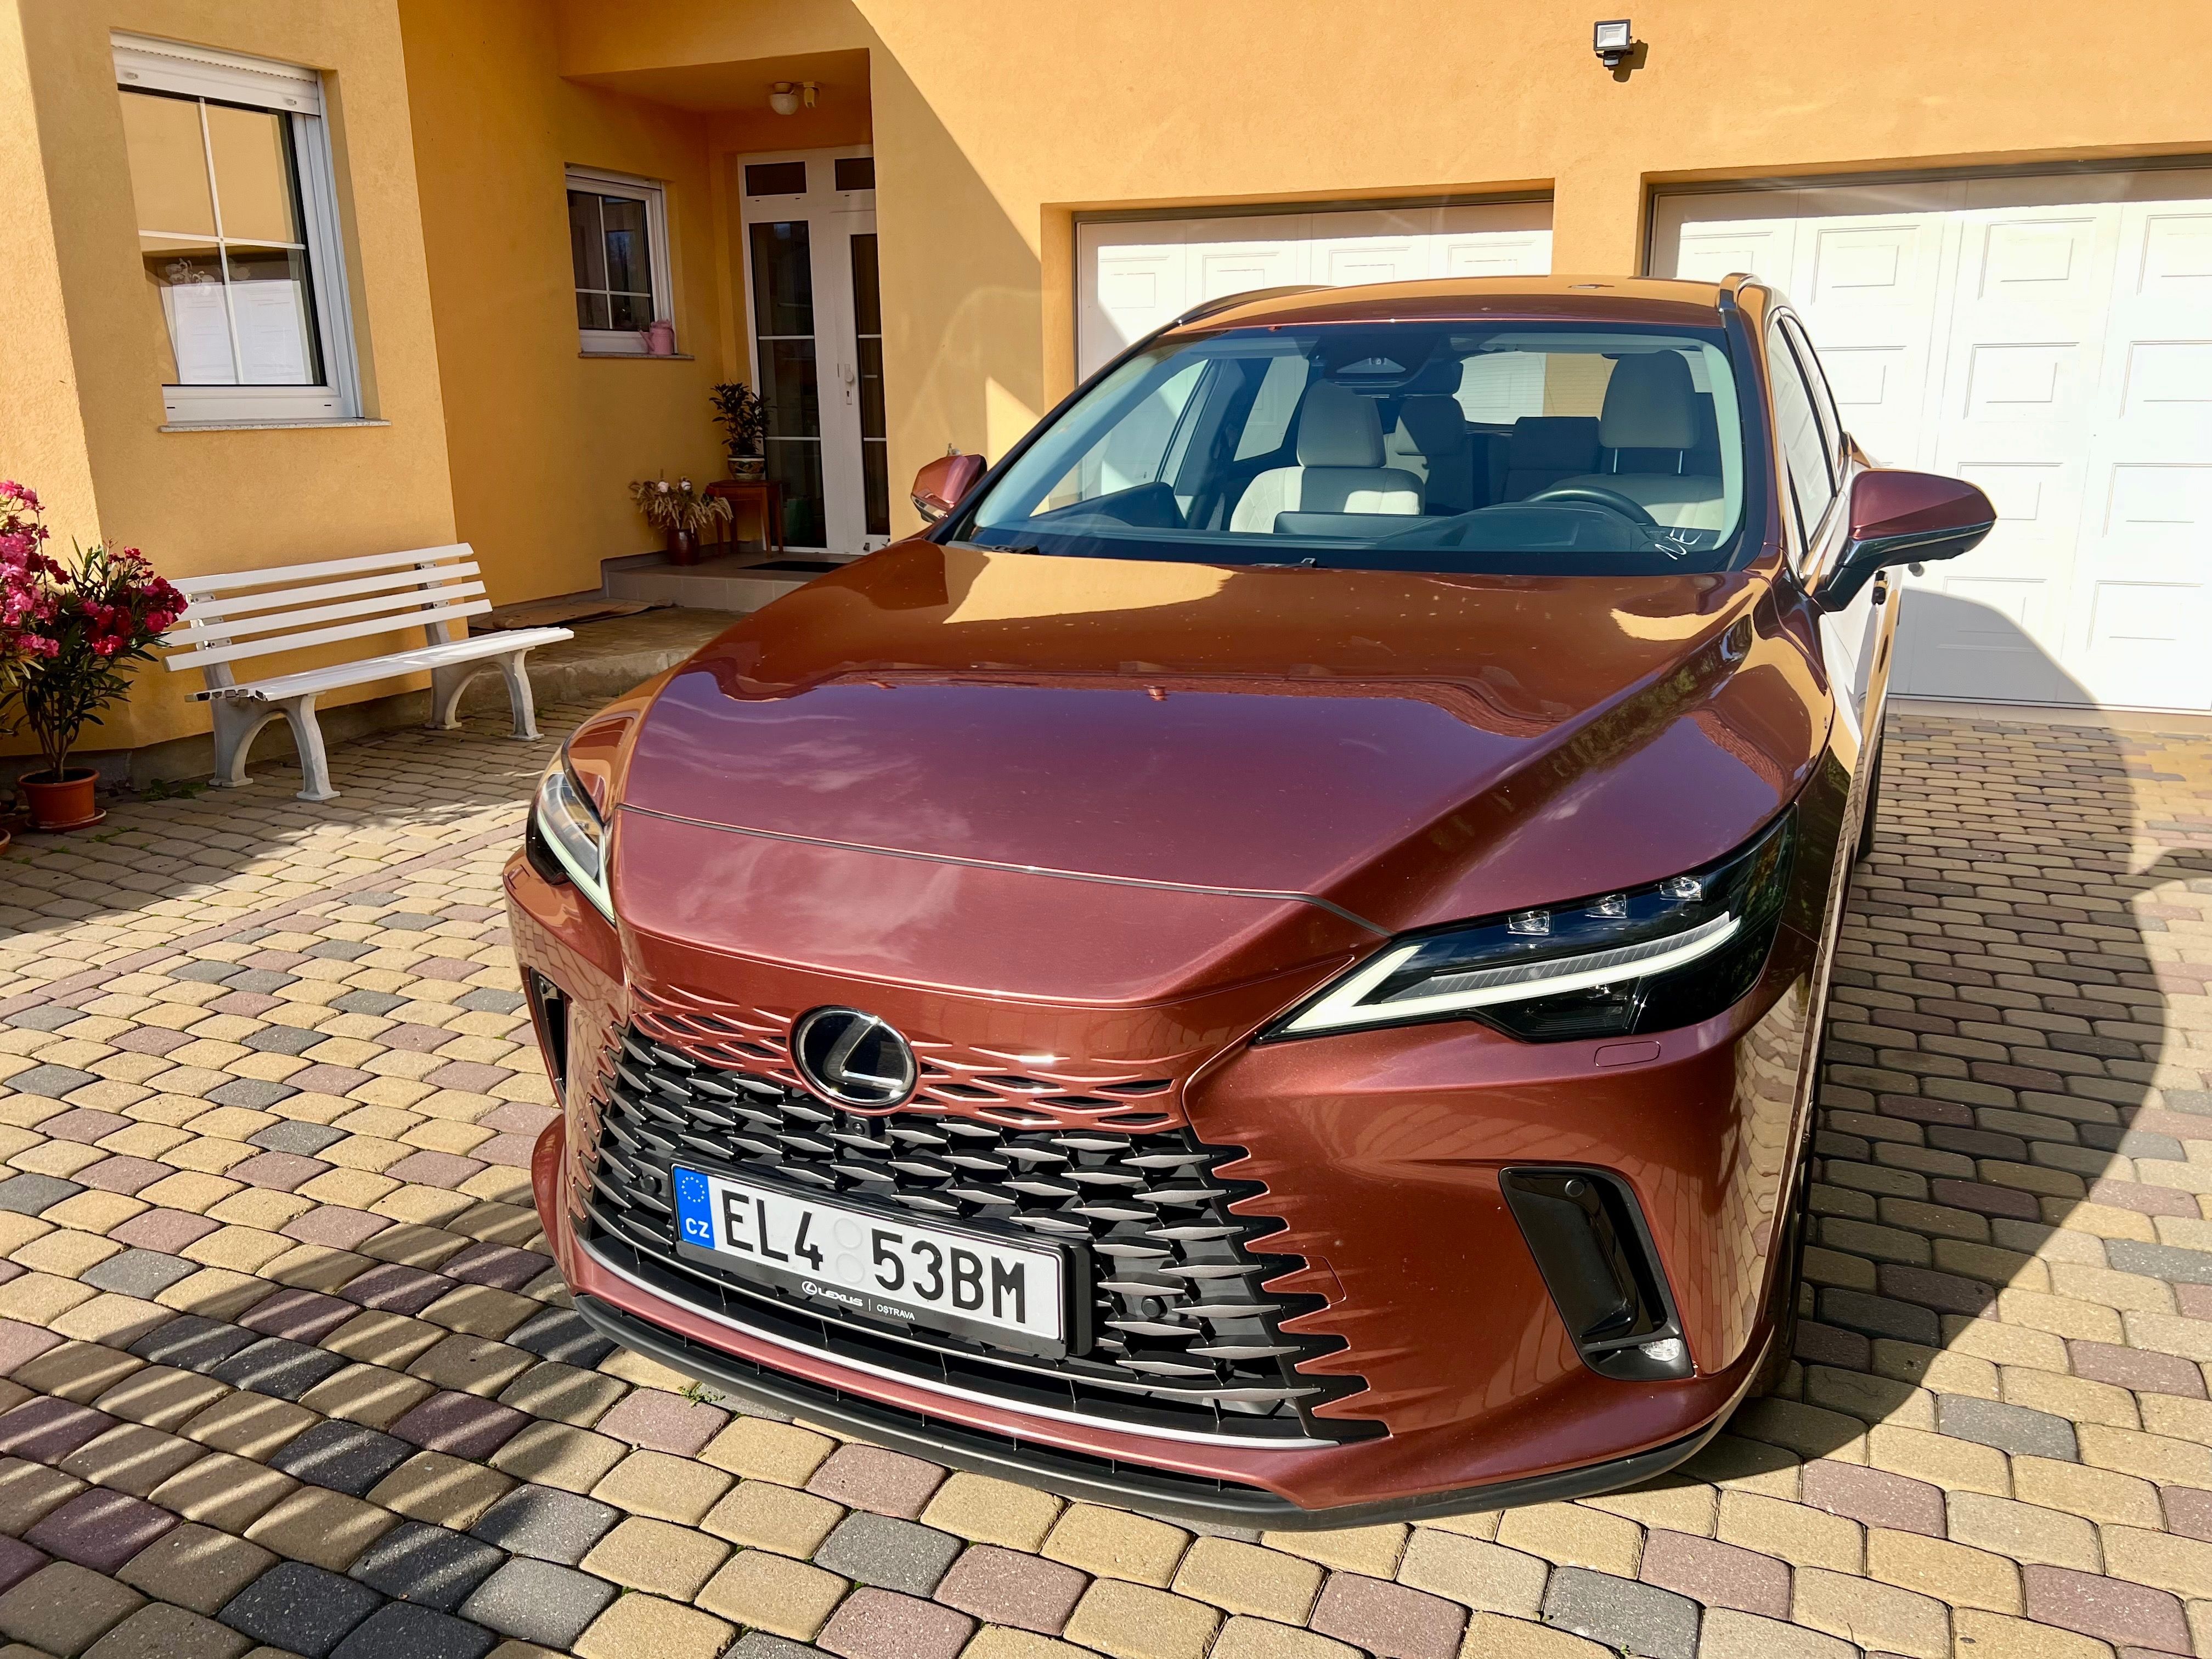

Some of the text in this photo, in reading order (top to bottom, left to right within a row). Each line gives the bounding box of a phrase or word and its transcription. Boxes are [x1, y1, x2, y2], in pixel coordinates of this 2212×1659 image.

[685, 1217, 710, 1239] CZ
[722, 1189, 1026, 1324] EL4 53BM
[818, 1287, 864, 1307] LEXUS
[876, 1304, 916, 1321] OSTRAVA
